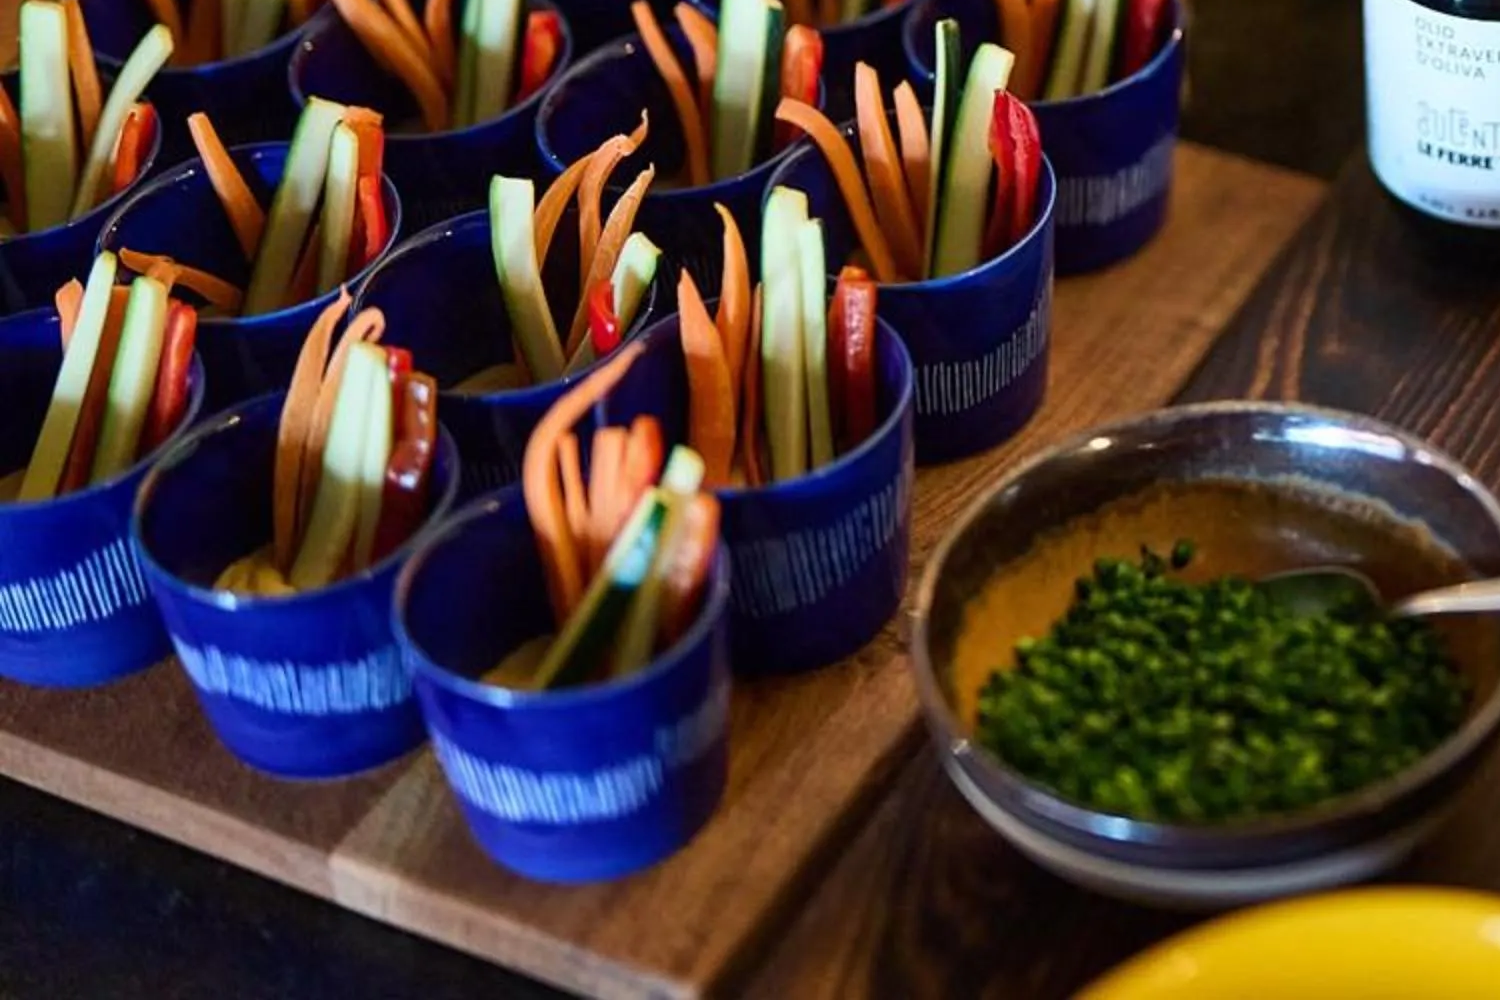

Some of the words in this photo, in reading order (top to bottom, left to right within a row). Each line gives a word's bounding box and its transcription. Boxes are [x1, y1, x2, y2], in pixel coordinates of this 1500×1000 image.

[1415, 15, 1455, 40] OLIO
[1416, 50, 1486, 81] D'OLIVA
[1417, 140, 1432, 157] LE
[1436, 147, 1494, 170] FERRE
